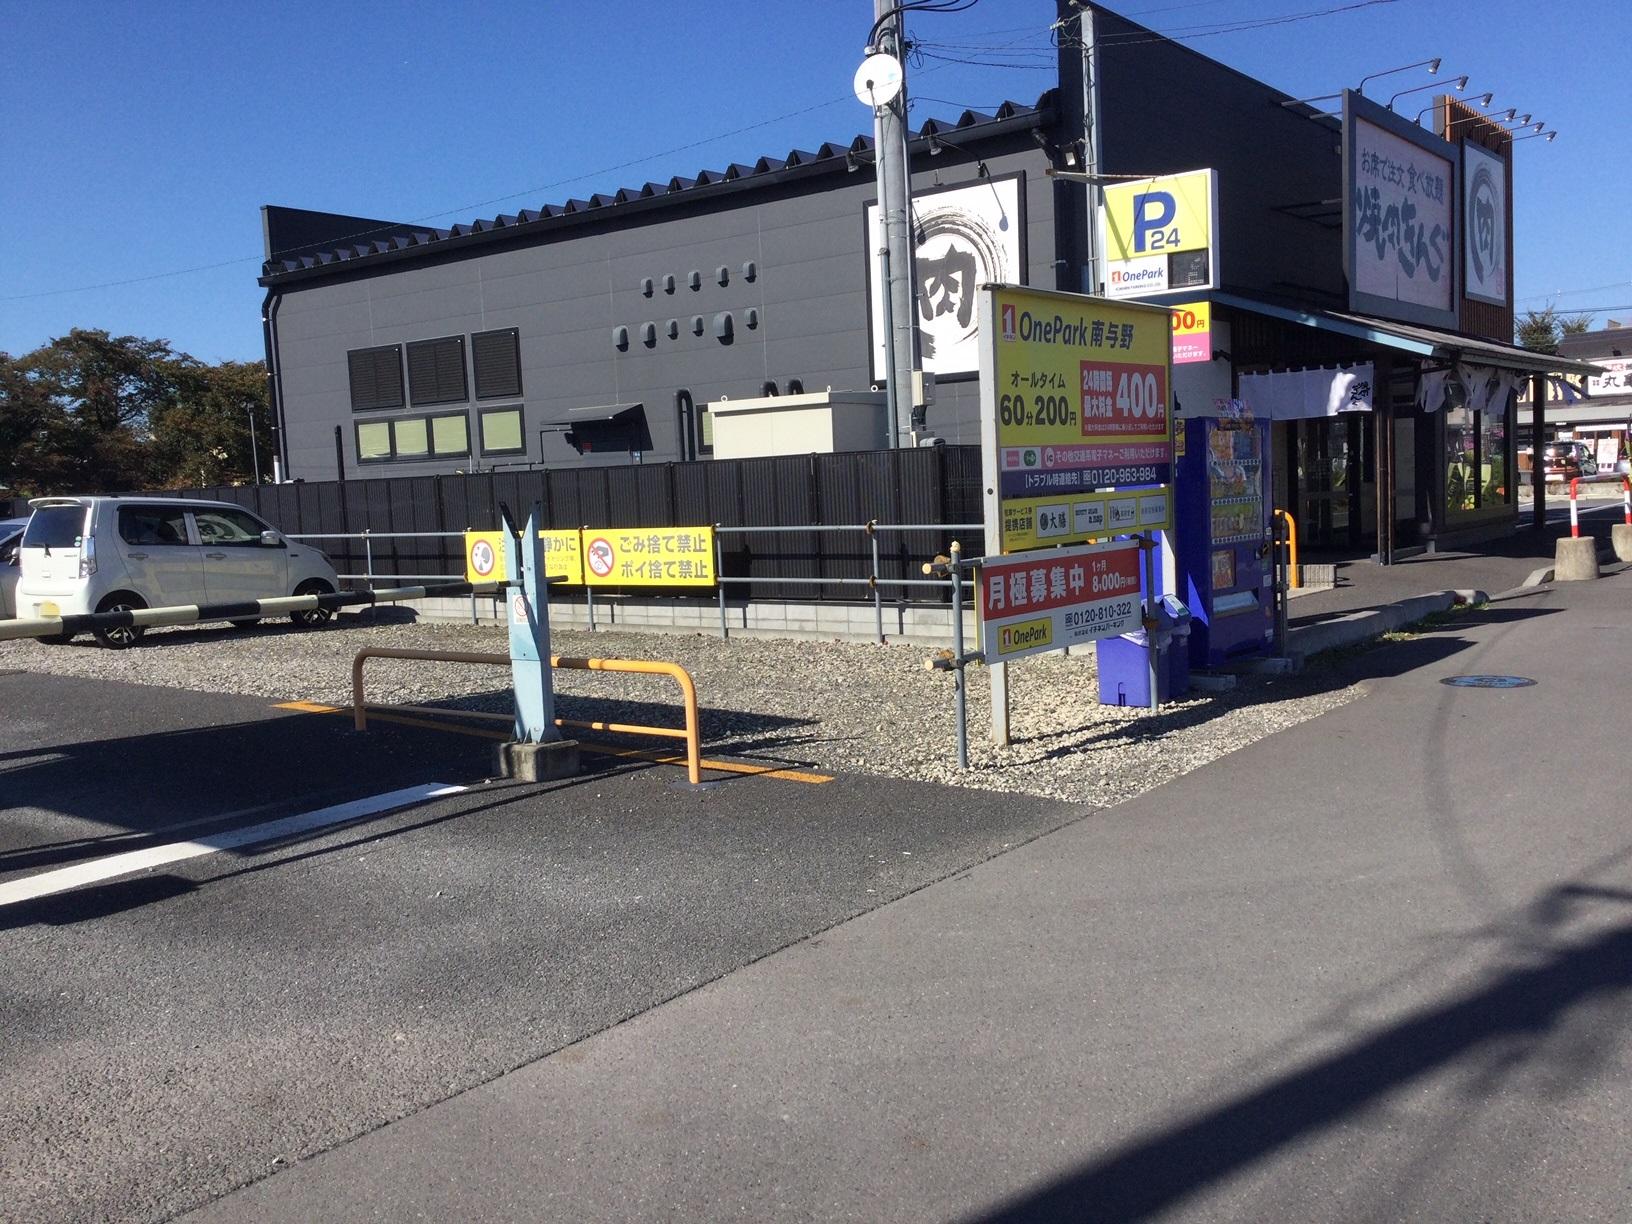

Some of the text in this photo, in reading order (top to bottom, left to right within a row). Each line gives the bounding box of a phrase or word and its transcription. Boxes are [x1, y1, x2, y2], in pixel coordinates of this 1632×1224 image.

[1133, 191, 1177, 253] P
[1150, 227, 1181, 250] 24
[914, 243, 977, 329] 肉
[1122, 268, 1164, 282] OnePark
[1019, 311, 1088, 347] OnePark
[1091, 319, 1135, 350] 南与野
[1011, 370, 1066, 389] オールタイム
[1084, 395, 1113, 418] 最大料金
[1116, 373, 1165, 419] 400円
[1091, 466, 1157, 485] 0120-963-984
[619, 533, 708, 555] ごみ捨て禁止
[620, 559, 709, 580] ポイ捨て禁止
[988, 563, 1085, 611] 月極募集中
[1073, 601, 1132, 626] 0120-810-322
[1013, 623, 1047, 645] OnePark
